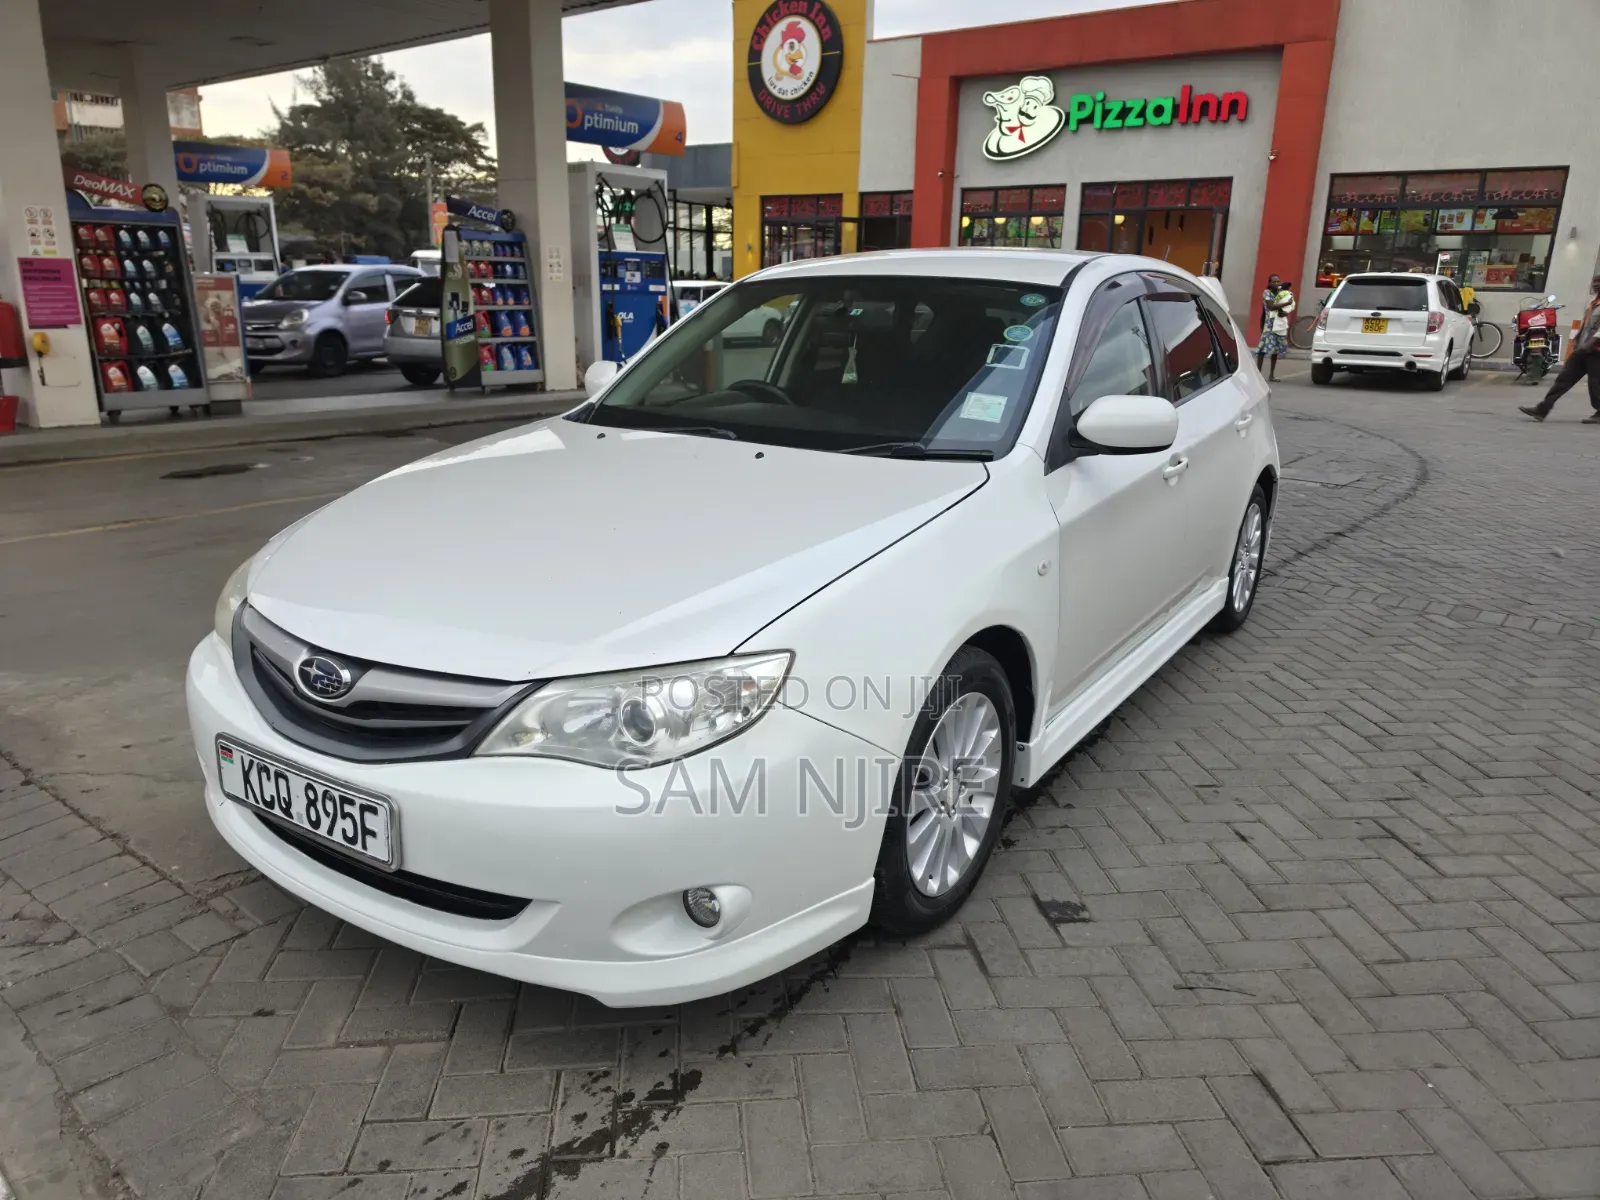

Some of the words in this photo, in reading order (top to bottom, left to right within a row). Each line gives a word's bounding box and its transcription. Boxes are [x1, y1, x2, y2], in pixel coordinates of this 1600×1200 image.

[752, 0, 808, 50] Chicken
[808, 2, 833, 41] Inn
[778, 87, 789, 96] dat
[790, 71, 814, 96] chicken
[758, 88, 791, 118] DRIVE
[795, 82, 827, 116] THRU
[675, 131, 683, 143] 4
[281, 171, 288, 180] 2
[73, 175, 136, 198] DeoMAX
[467, 205, 498, 222] Accel
[455, 318, 474, 333] Accel
[617, 311, 634, 320] OLA
[240, 754, 293, 819] KCQ
[304, 781, 379, 851] 895F
